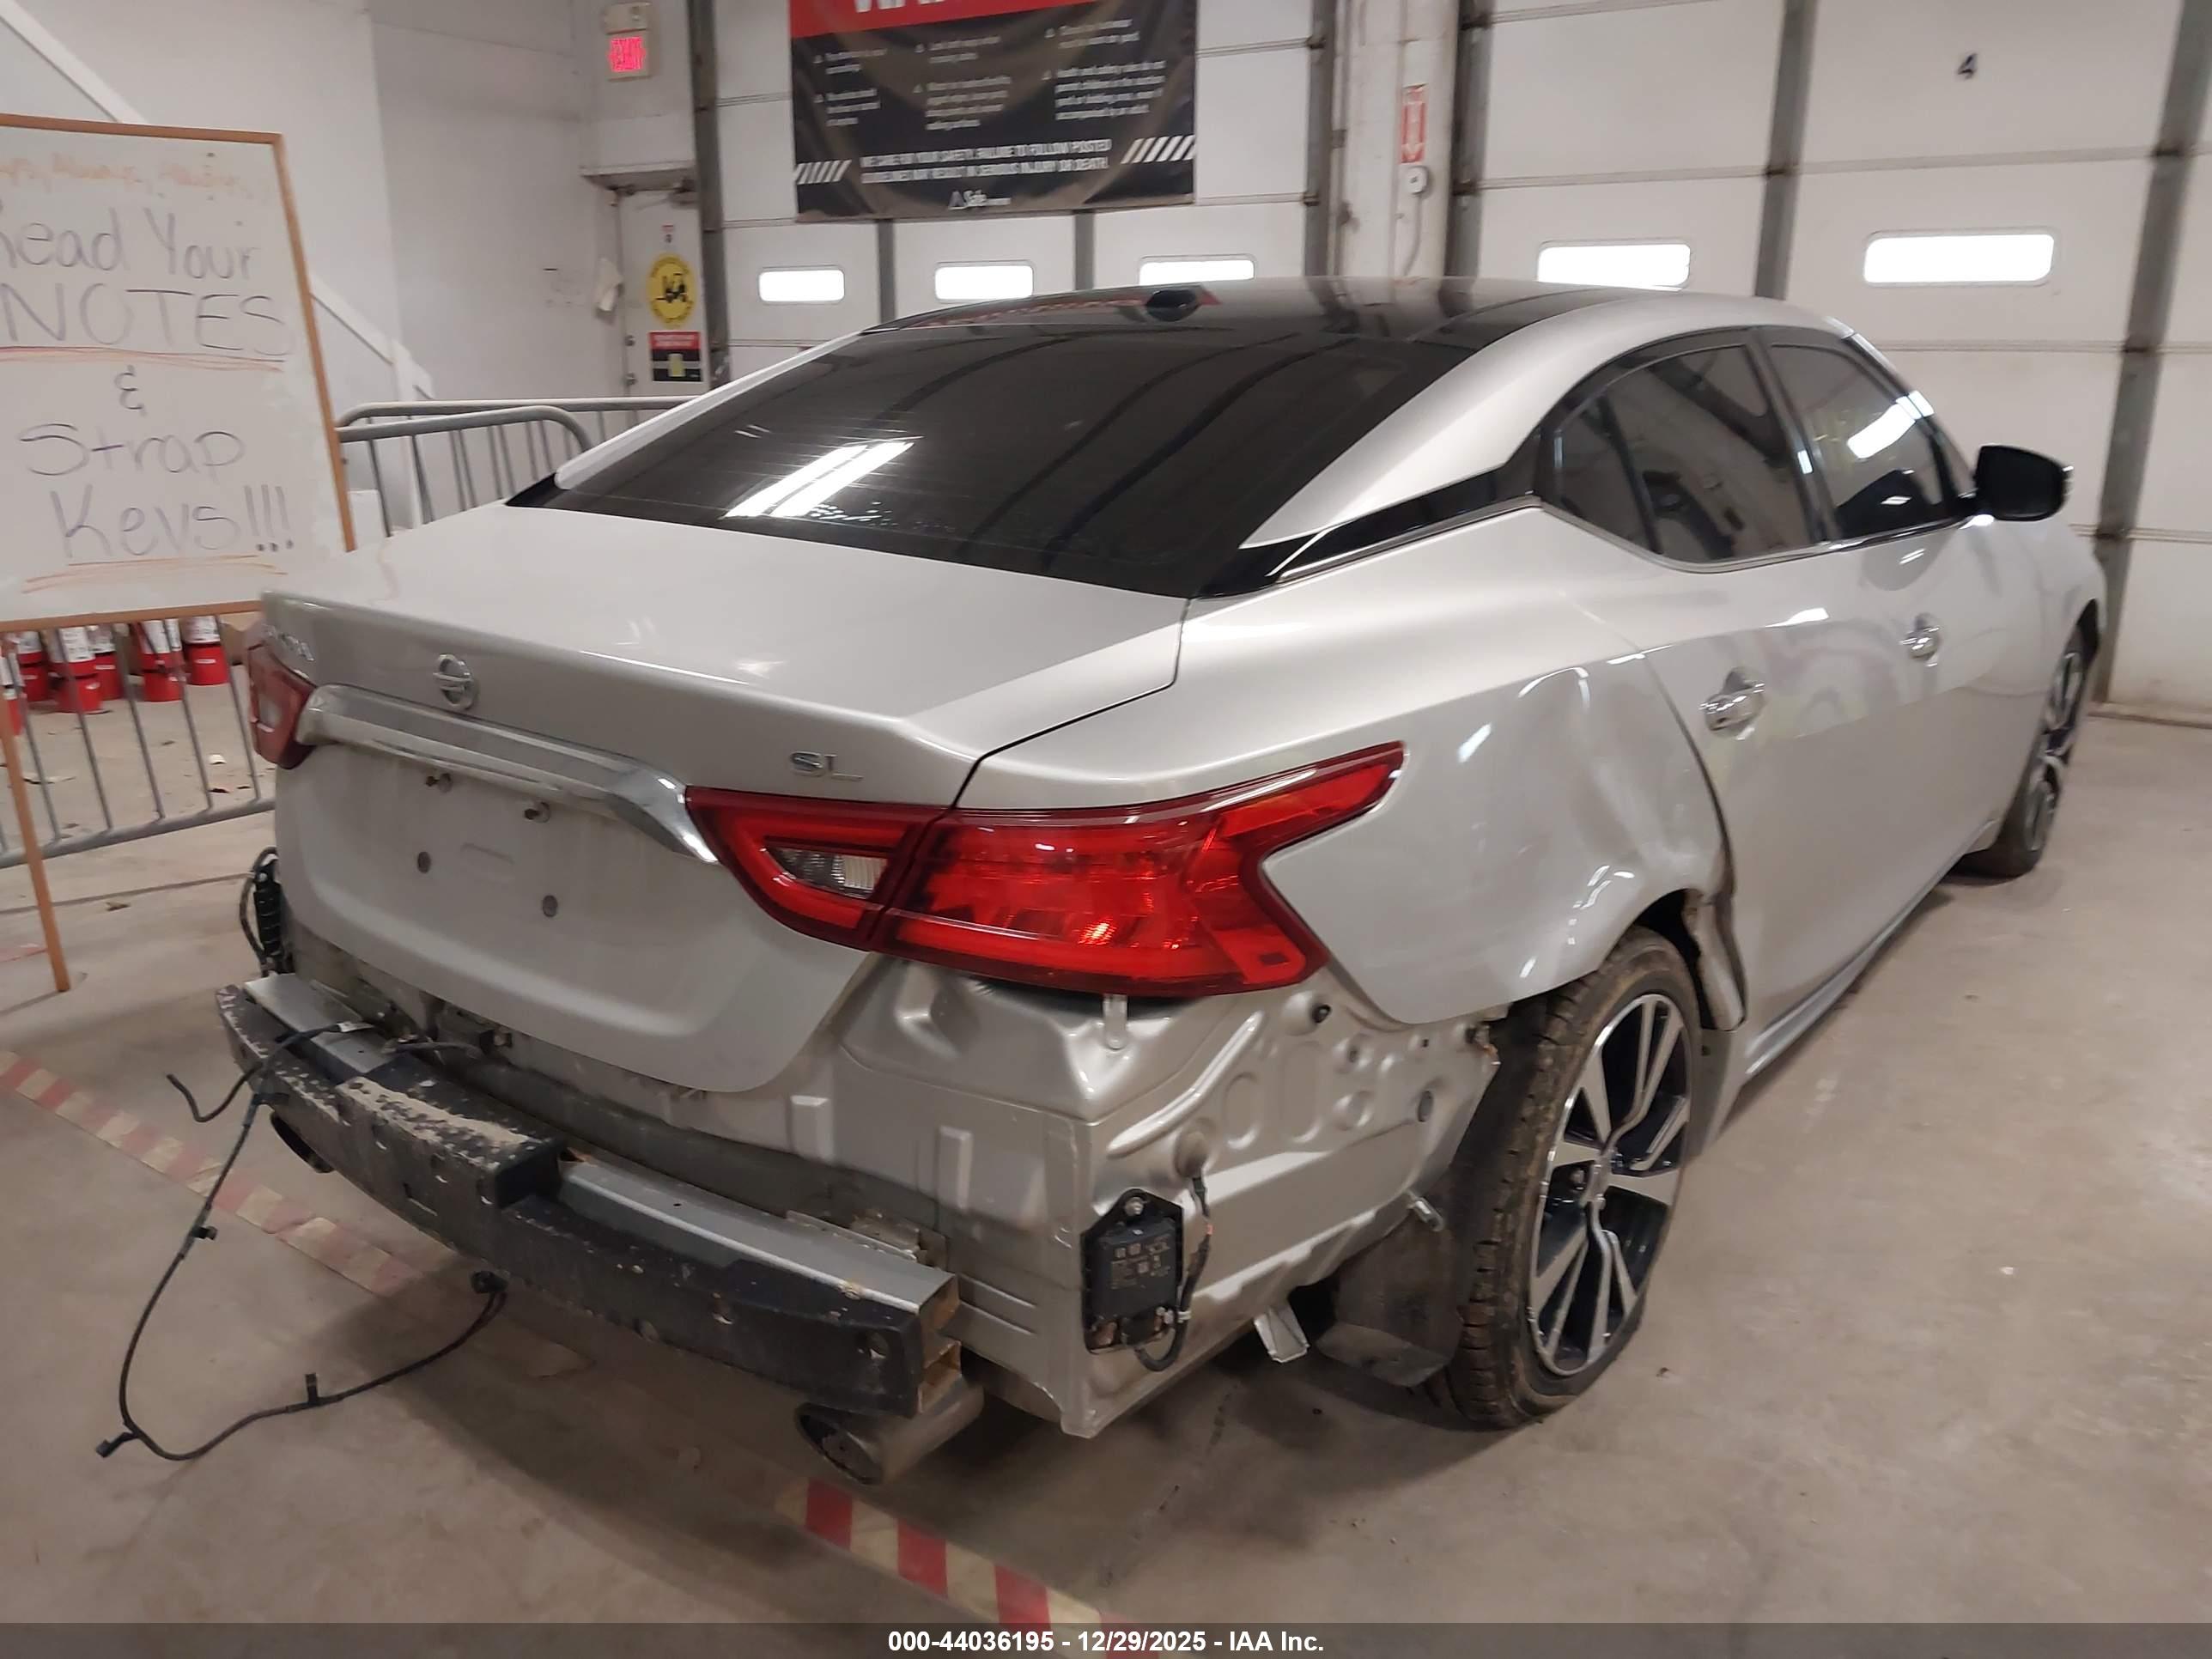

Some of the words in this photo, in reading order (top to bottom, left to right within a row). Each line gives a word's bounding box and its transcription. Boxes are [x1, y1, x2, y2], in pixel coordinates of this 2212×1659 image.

[1957, 52, 1978, 80] 4
[0, 199, 128, 271] ead
[143, 207, 261, 279] Your
[0, 283, 293, 356] NOTES
[18, 422, 246, 483] Strap
[790, 750, 864, 781] SL
